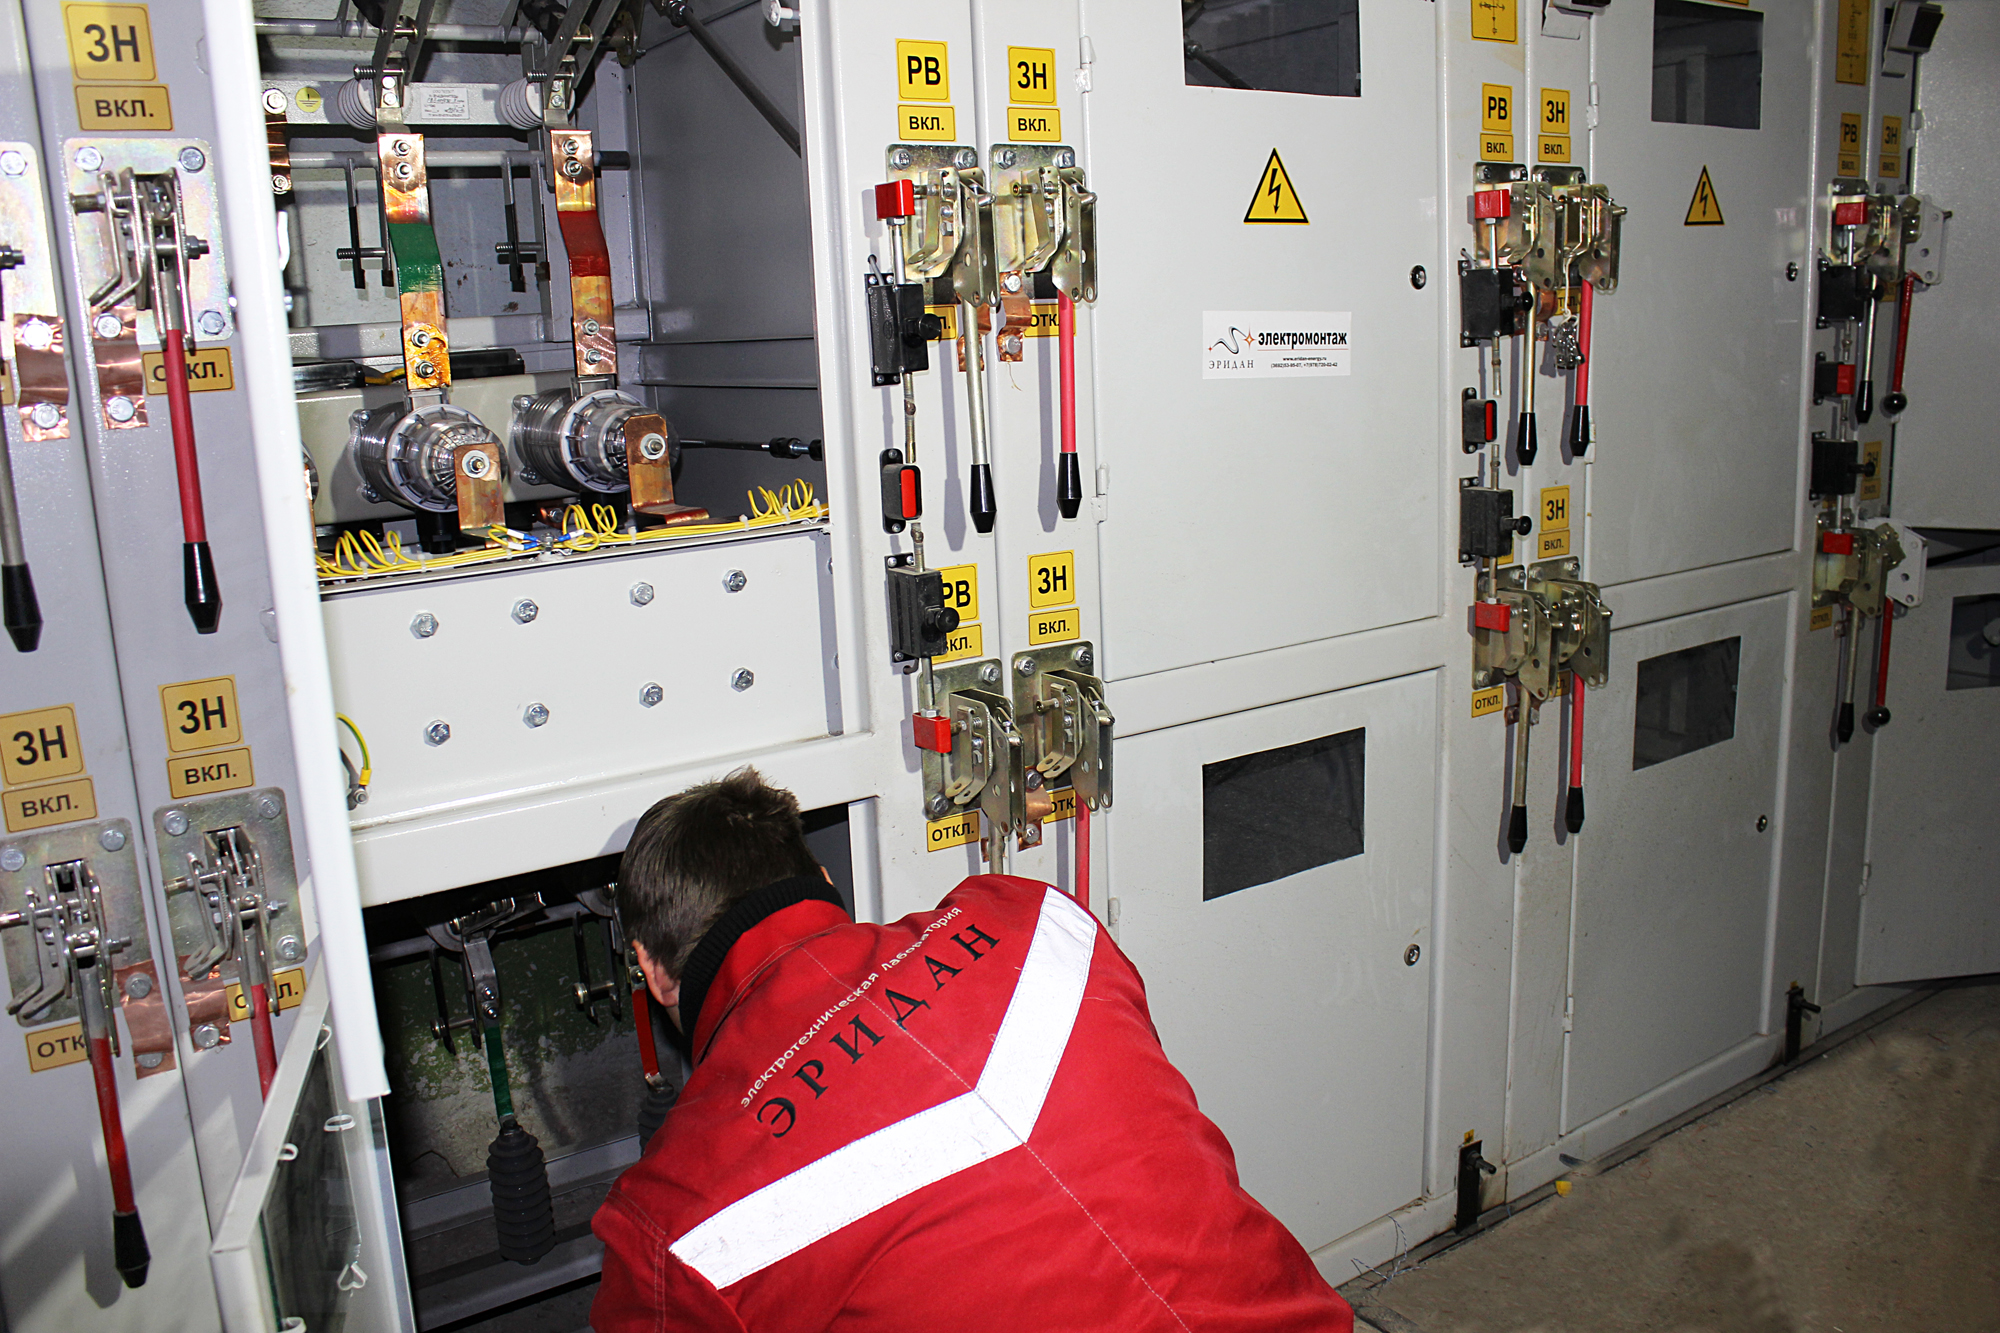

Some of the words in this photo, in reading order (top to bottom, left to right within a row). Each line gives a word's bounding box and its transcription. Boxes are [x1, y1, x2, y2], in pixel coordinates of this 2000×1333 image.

[84, 24, 141, 62] ЗН
[907, 55, 941, 85] РВ
[1017, 61, 1048, 90] ЗН
[95, 100, 154, 118] ВКЛ.
[1487, 96, 1508, 120] РВ
[1546, 100, 1565, 124] ЗН
[909, 116, 945, 131] ВКЛ.
[1018, 118, 1051, 132] ВКЛ.
[1843, 123, 1857, 143] РВ
[1884, 126, 1898, 145] ЗН
[1486, 142, 1508, 154] ВКЛ.
[1544, 143, 1565, 155] ВКЛ.
[1258, 332, 1347, 350] электромонтаж
[153, 362, 224, 382] ОКЛ.
[1209, 360, 1254, 370] ЭРИДАН
[1546, 498, 1565, 521] ЗН
[1544, 538, 1564, 550] ВКЛ.
[1038, 565, 1067, 595] ЗН
[1038, 619, 1071, 635] ВКЛ.
[1475, 694, 1501, 710] ОТКЛ.
[177, 695, 228, 734] ЗН
[13, 725, 68, 766] ЗН
[185, 763, 237, 785] ВКЛ.
[21, 794, 79, 818] ВКЛ.
[931, 822, 975, 842] ОТКЛ.
[741, 972, 879, 1108] электротехническая
[881, 906, 963, 971] лаборатория
[756, 924, 1000, 1138] ЭРИДАН
